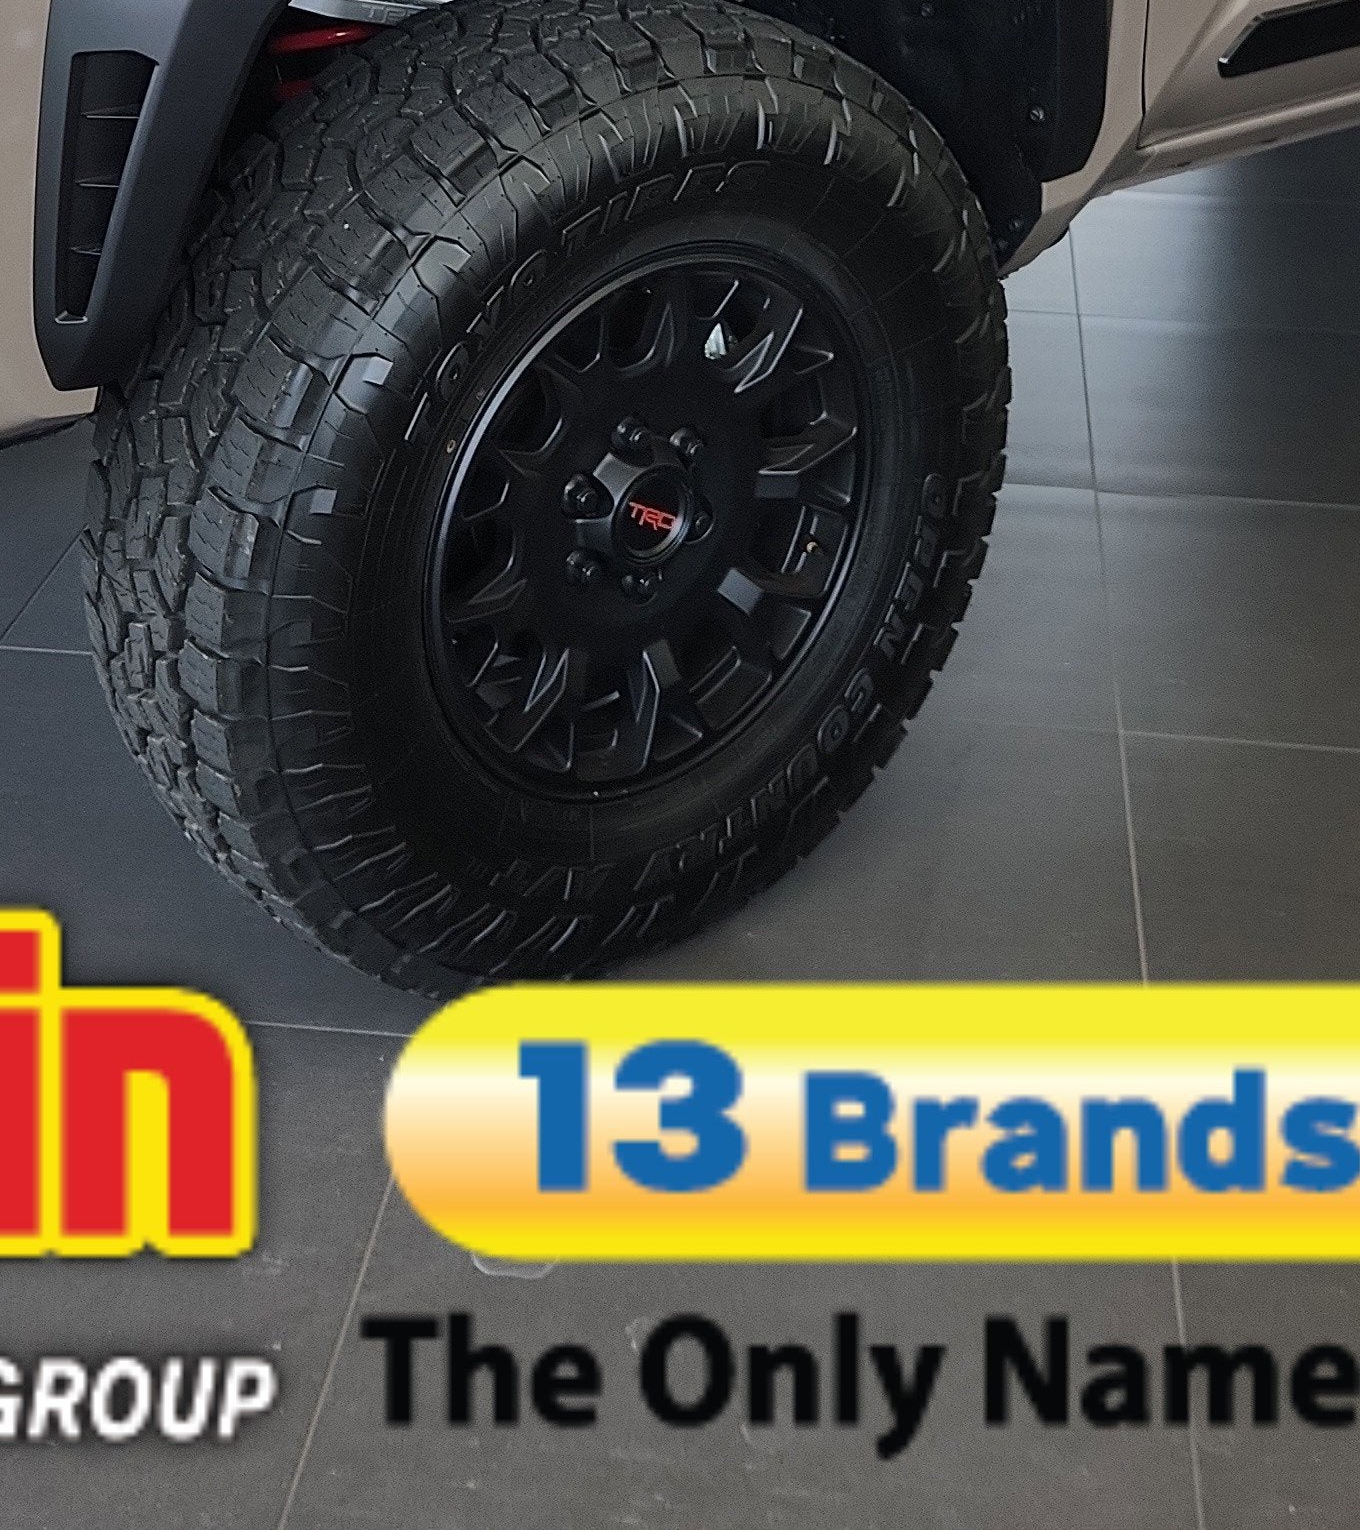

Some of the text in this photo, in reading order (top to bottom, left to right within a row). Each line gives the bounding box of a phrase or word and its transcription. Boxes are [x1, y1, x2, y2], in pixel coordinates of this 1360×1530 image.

[362, 3, 409, 24] TR
[629, 501, 676, 531] TRD
[873, 472, 946, 660] OPEN
